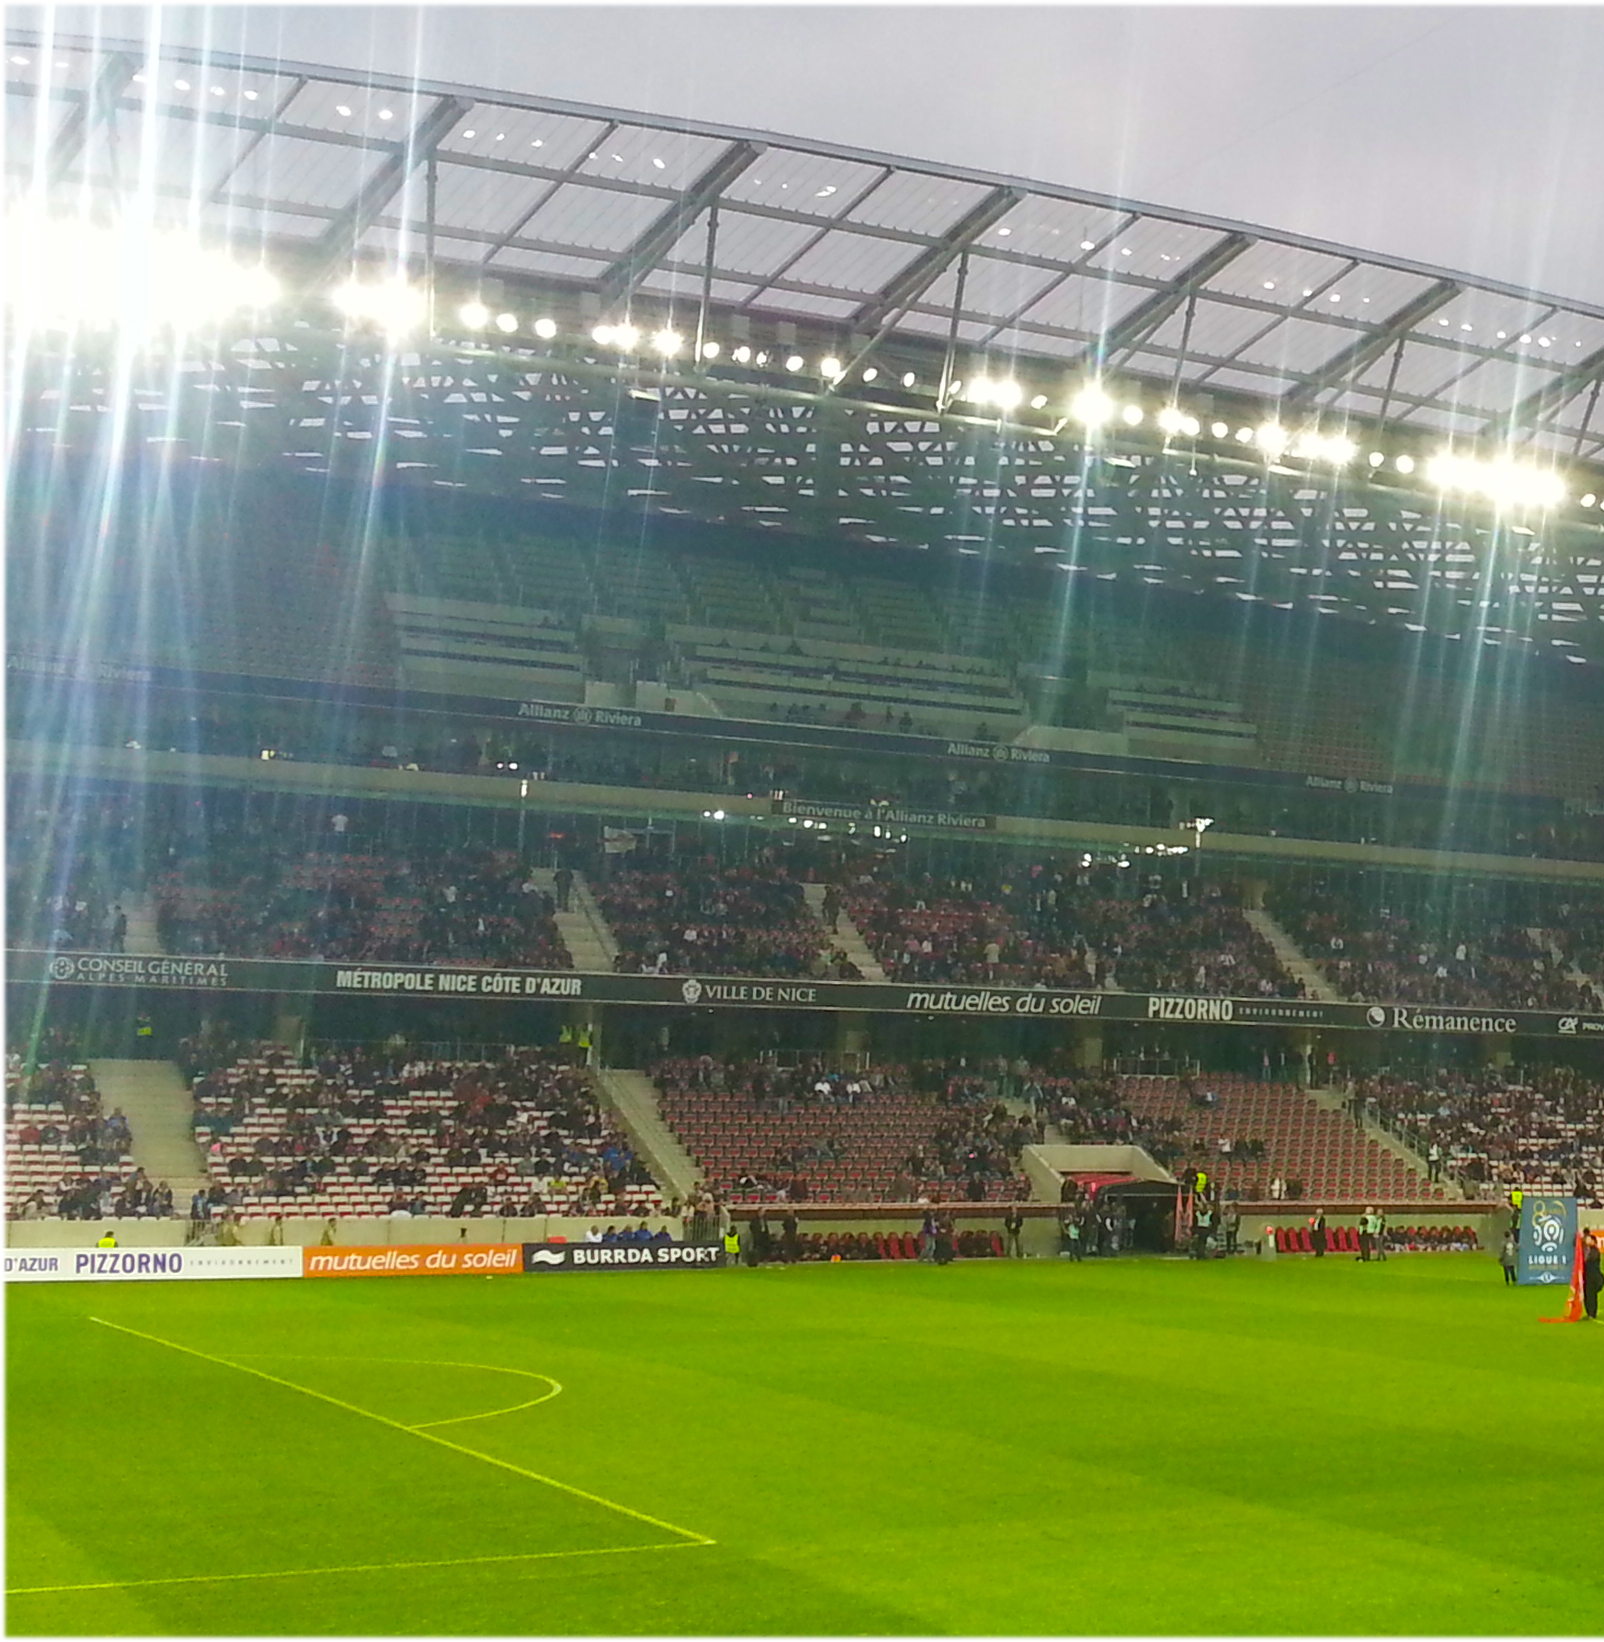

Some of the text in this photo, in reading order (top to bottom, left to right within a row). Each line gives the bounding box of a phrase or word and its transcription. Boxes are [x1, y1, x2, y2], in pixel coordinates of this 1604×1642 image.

[517, 702, 642, 727] Allianz Riviera
[947, 743, 1050, 763] Allianz Riviera
[782, 800, 986, 828] Bienvenue à l'Allianz Riviera
[76, 972, 125, 983] ALPES
[77, 957, 228, 977] CONSEIL GÉNÉRAL
[336, 968, 582, 996] MÉTROPOLE NICE CÔTE D'AZUR
[705, 985, 817, 1002] VILLE DE NICE
[906, 991, 1102, 1015] mutuelles du soleil
[1148, 997, 1233, 1021] PIZZORNO
[1392, 1007, 1518, 1033] Rémanence
[4, 1257, 58, 1272] D'AZUR
[75, 1253, 182, 1274] PIZZORNO
[309, 1249, 517, 1271] mutuelles du soleil
[573, 1247, 720, 1264] BURRDA SPORT
